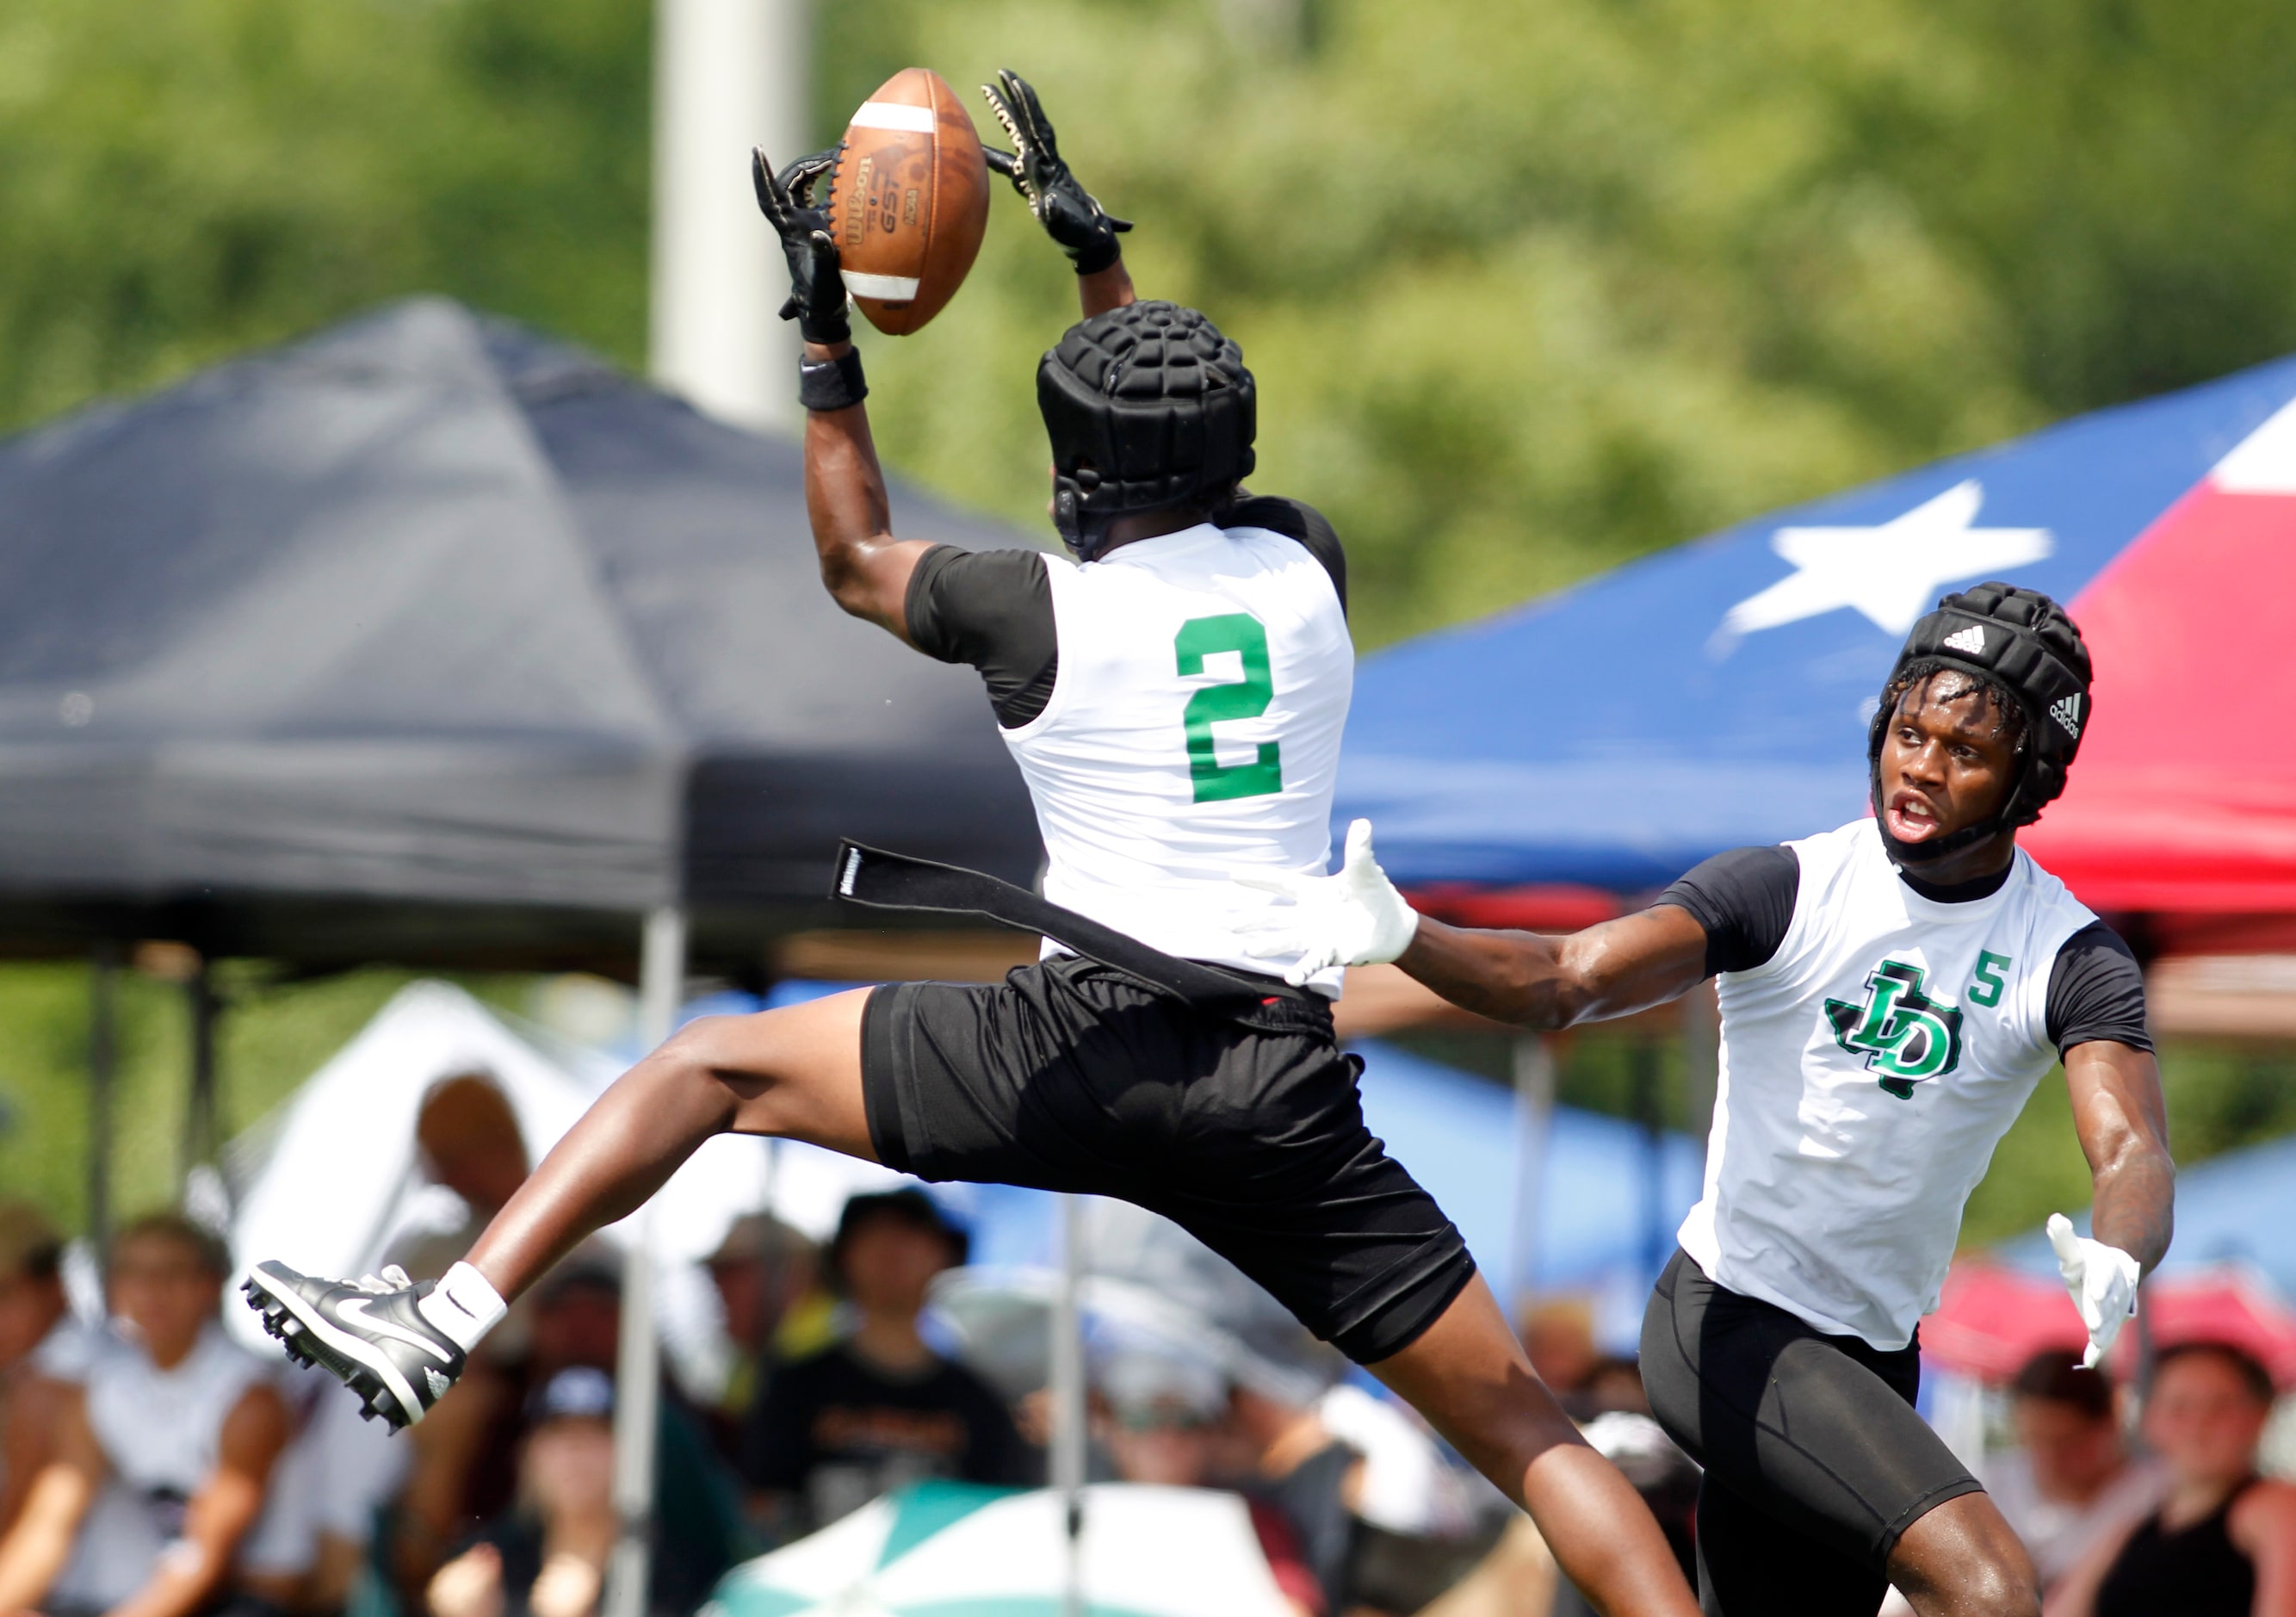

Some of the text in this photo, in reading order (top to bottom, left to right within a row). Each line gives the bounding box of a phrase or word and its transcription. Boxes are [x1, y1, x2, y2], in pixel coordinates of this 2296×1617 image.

[846, 157, 873, 245] Wilson
[881, 171, 900, 233] GST
[1174, 612, 1283, 803] 2
[2050, 704, 2079, 739] adidas
[1968, 949, 2012, 1007] 5
[1846, 971, 1952, 1081] LD
